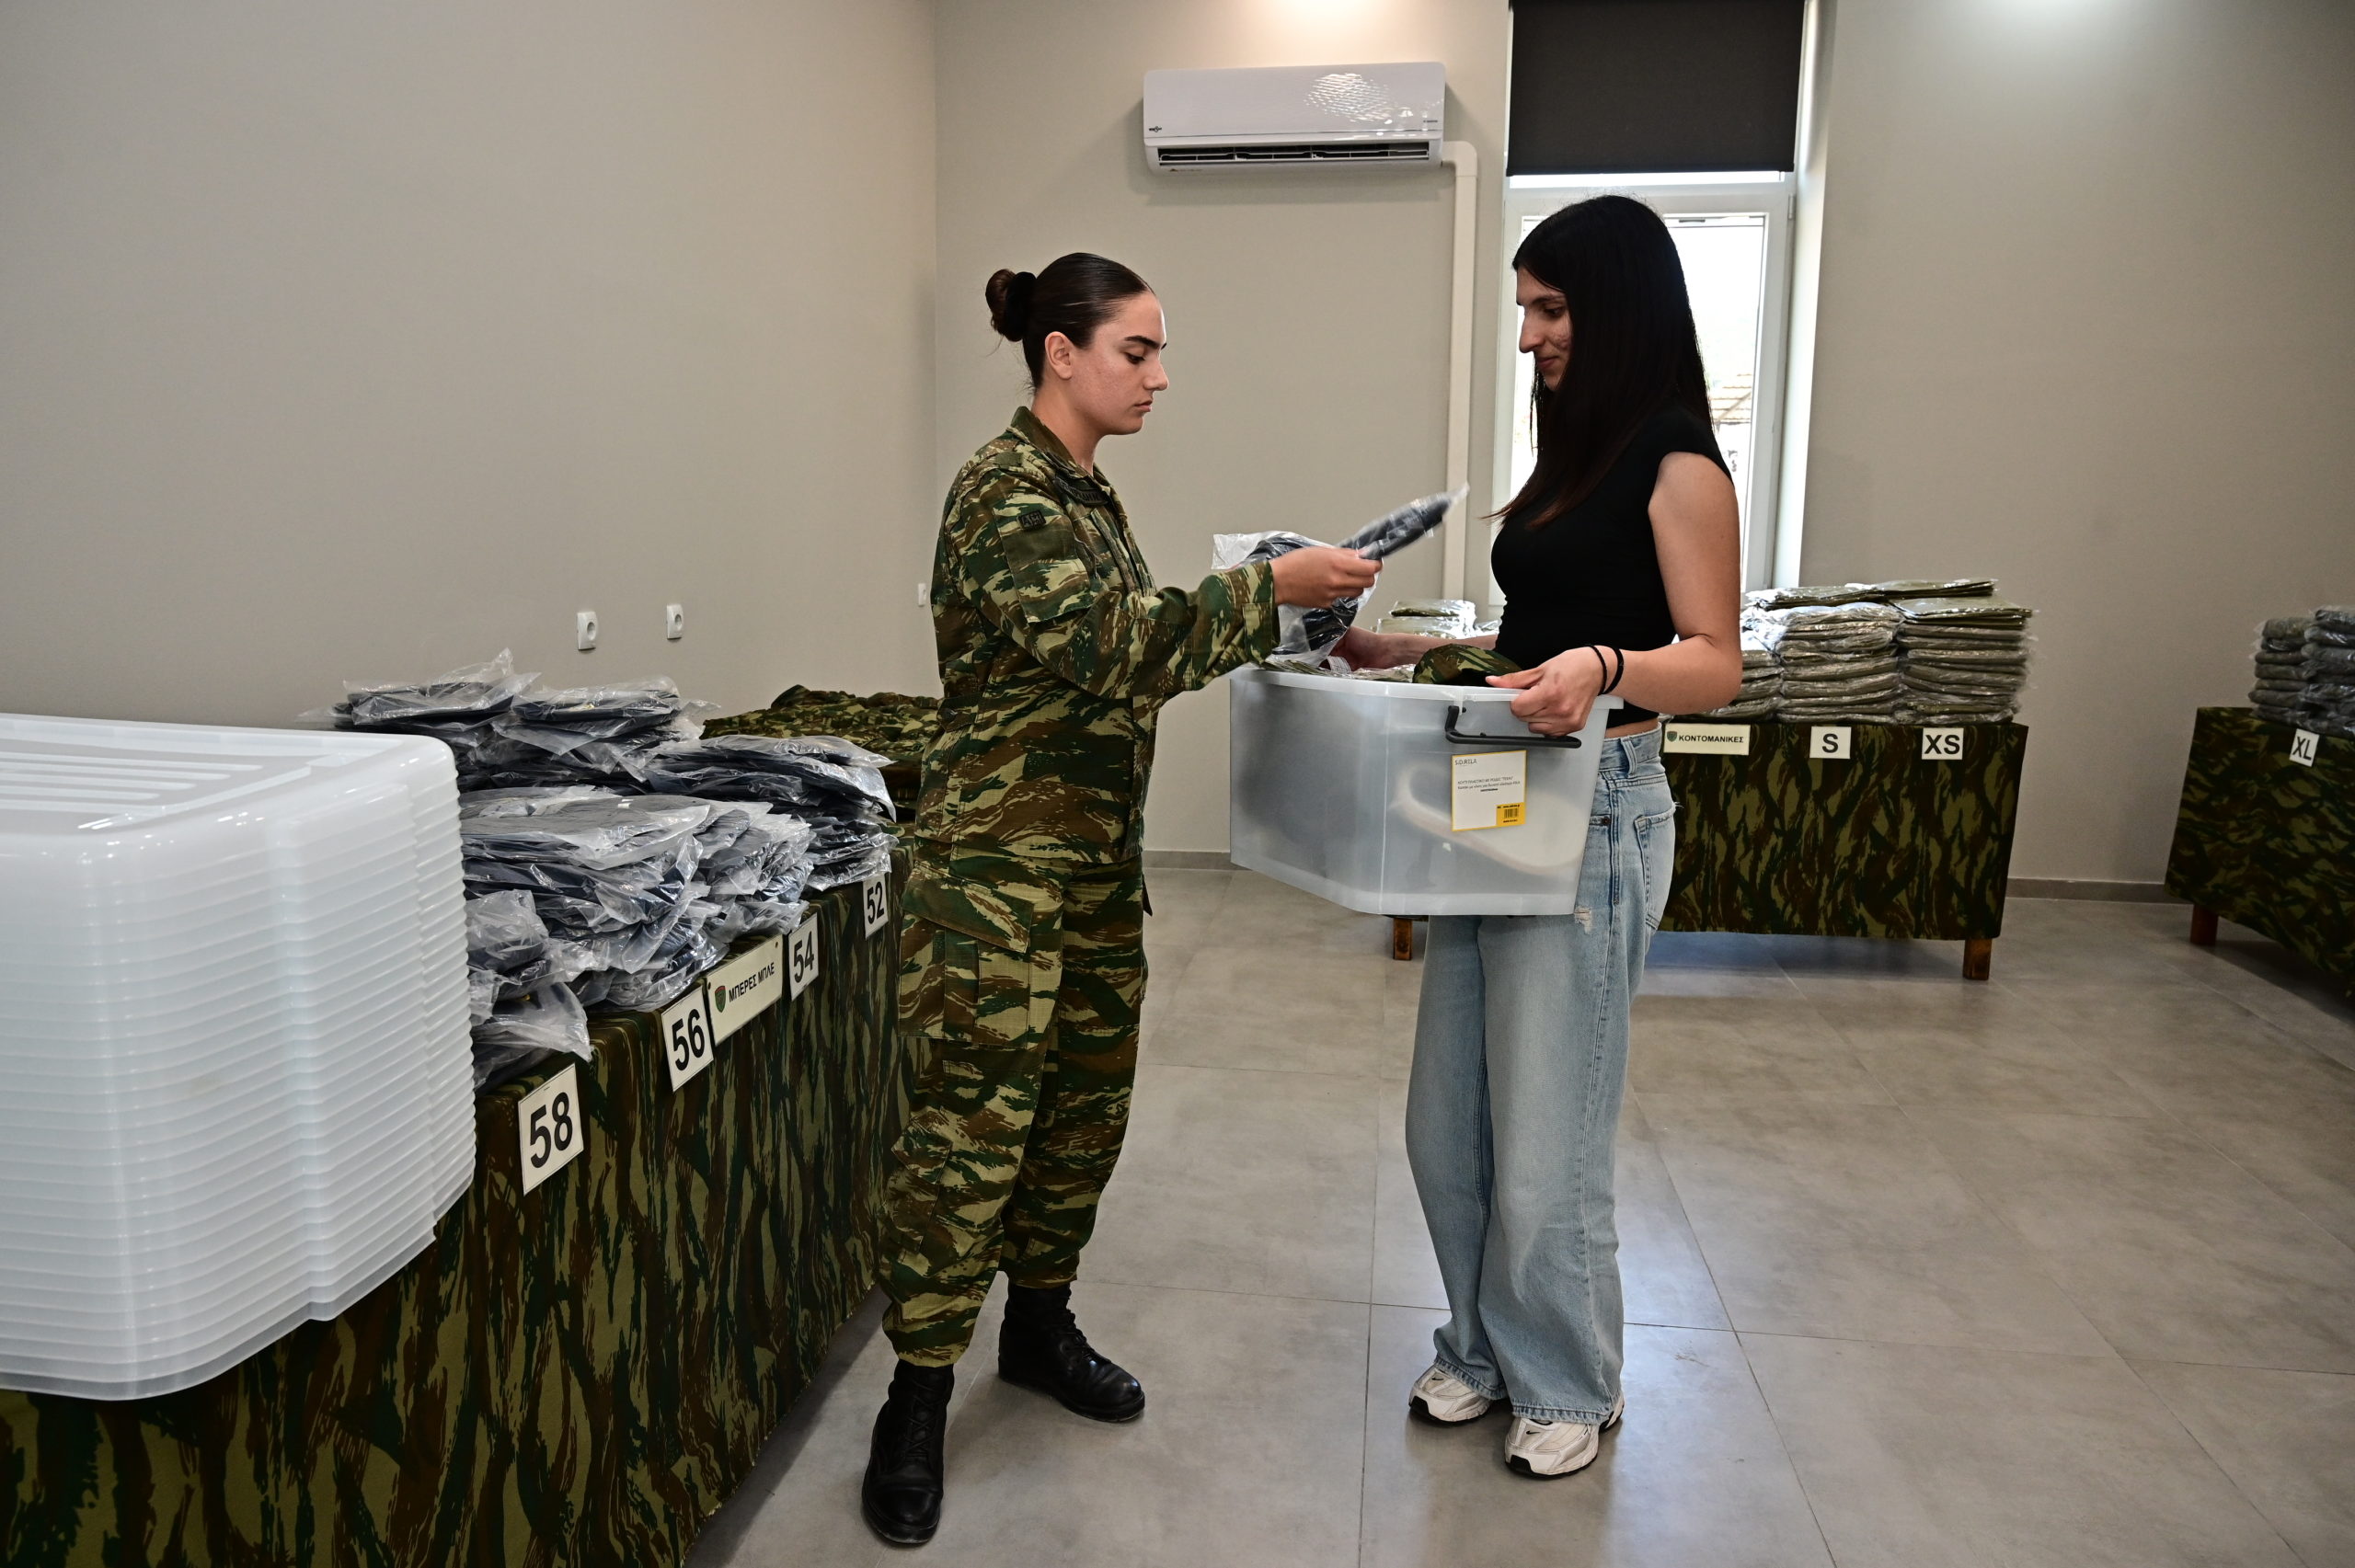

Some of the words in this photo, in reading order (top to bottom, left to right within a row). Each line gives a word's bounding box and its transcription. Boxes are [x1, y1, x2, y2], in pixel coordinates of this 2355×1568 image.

[1678, 735, 1744, 743] ΚΟΝΤΟΜΑΝΙΚΕΣ
[1821, 733, 1839, 754] S
[1924, 735, 1961, 755] XS
[2292, 737, 2312, 761] XL
[867, 881, 885, 924] 52
[793, 931, 815, 983] 54
[729, 973, 757, 1002] ΜΠΕΡΕΣ
[757, 961, 775, 984] ΜΠΛΕ
[672, 1008, 706, 1071] 56
[530, 1092, 573, 1169] 58
